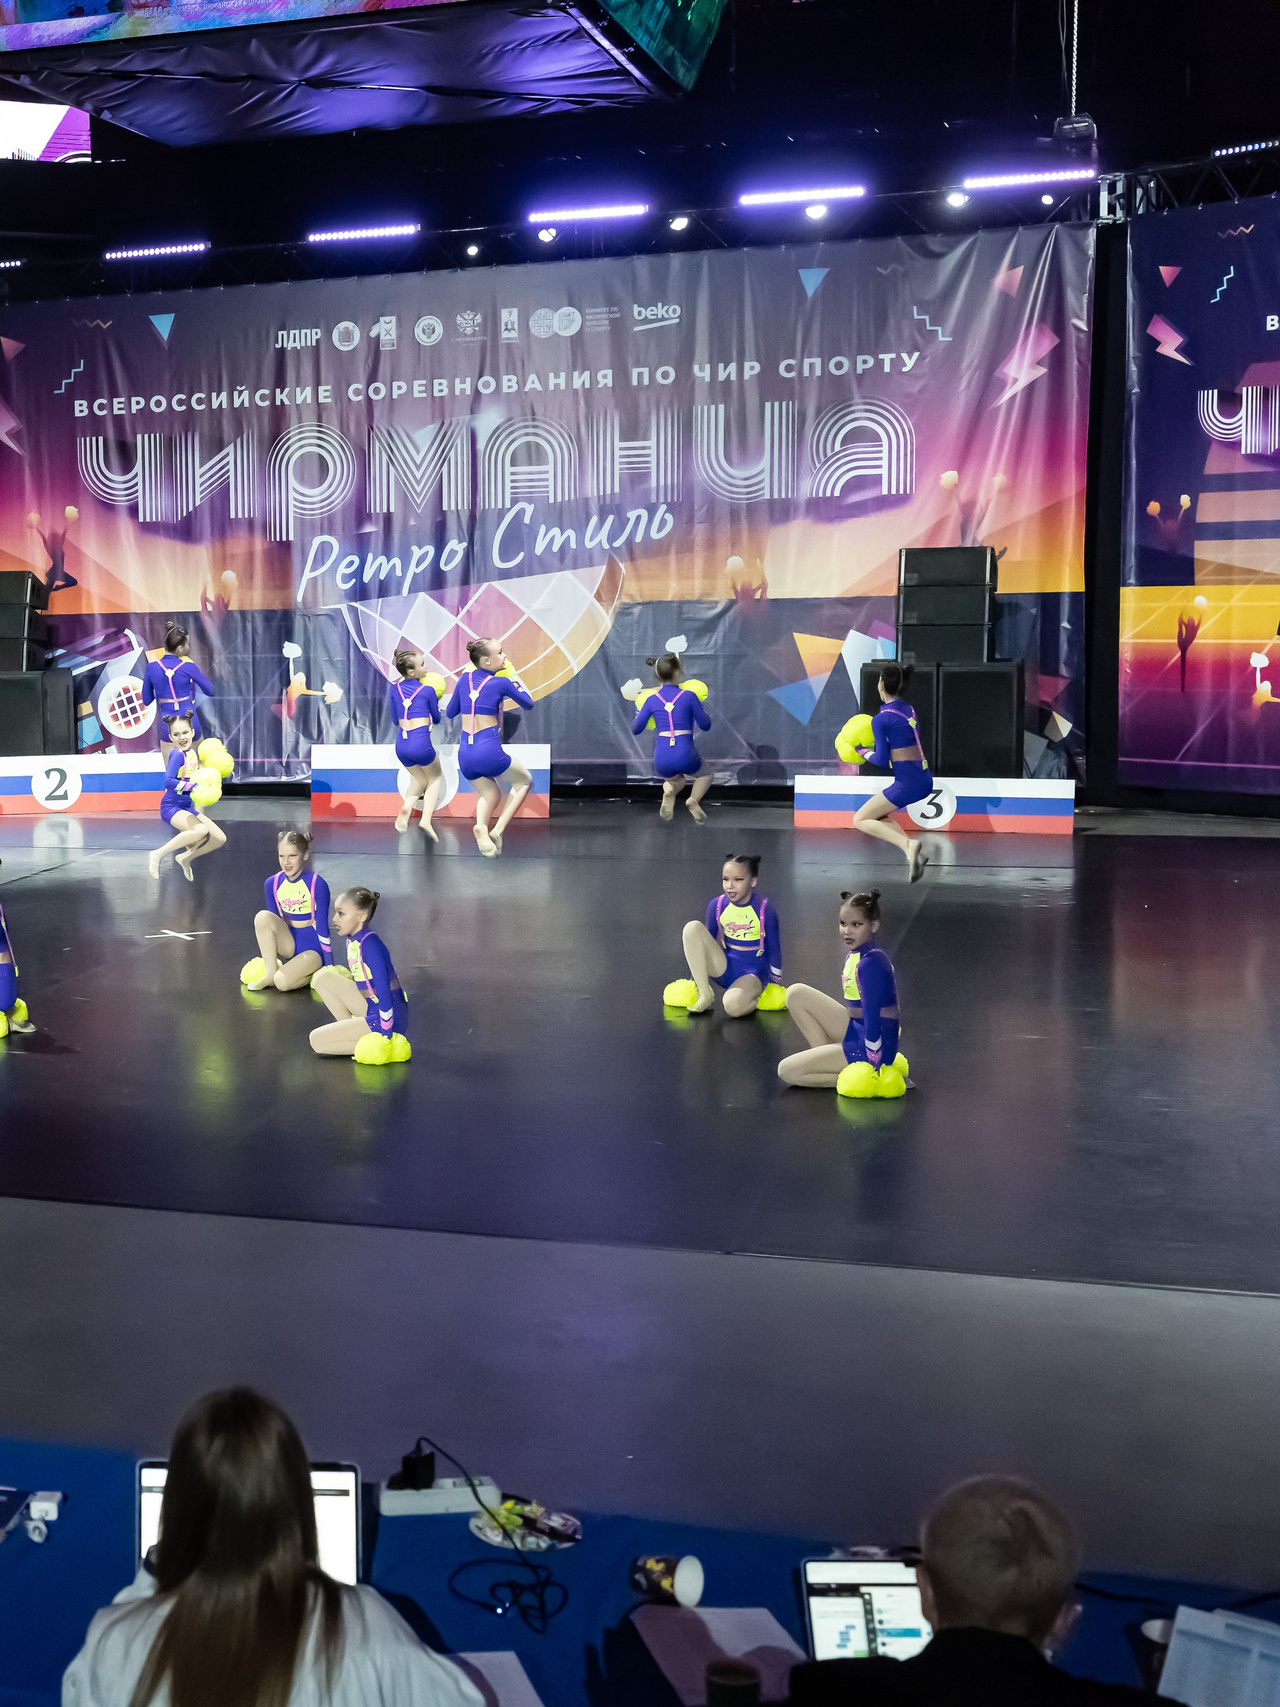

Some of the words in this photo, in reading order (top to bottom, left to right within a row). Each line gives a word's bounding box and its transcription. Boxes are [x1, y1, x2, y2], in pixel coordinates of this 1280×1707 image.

[633, 302, 682, 320] beko
[275, 328, 322, 350] ЛДПР
[74, 384, 332, 417] ВСЕРОССИЙСКИЕ
[347, 369, 614, 402] СОРЕВНОВАНИЯ
[631, 365, 676, 386] ПО
[693, 361, 761, 382] ЧИР
[778, 351, 920, 378] СПОРТУ
[1197, 385, 1280, 455] Ч
[297, 535, 469, 602] Ретро
[491, 502, 674, 569] Стиль
[44, 767, 69, 801] 2
[919, 789, 944, 820] 3
